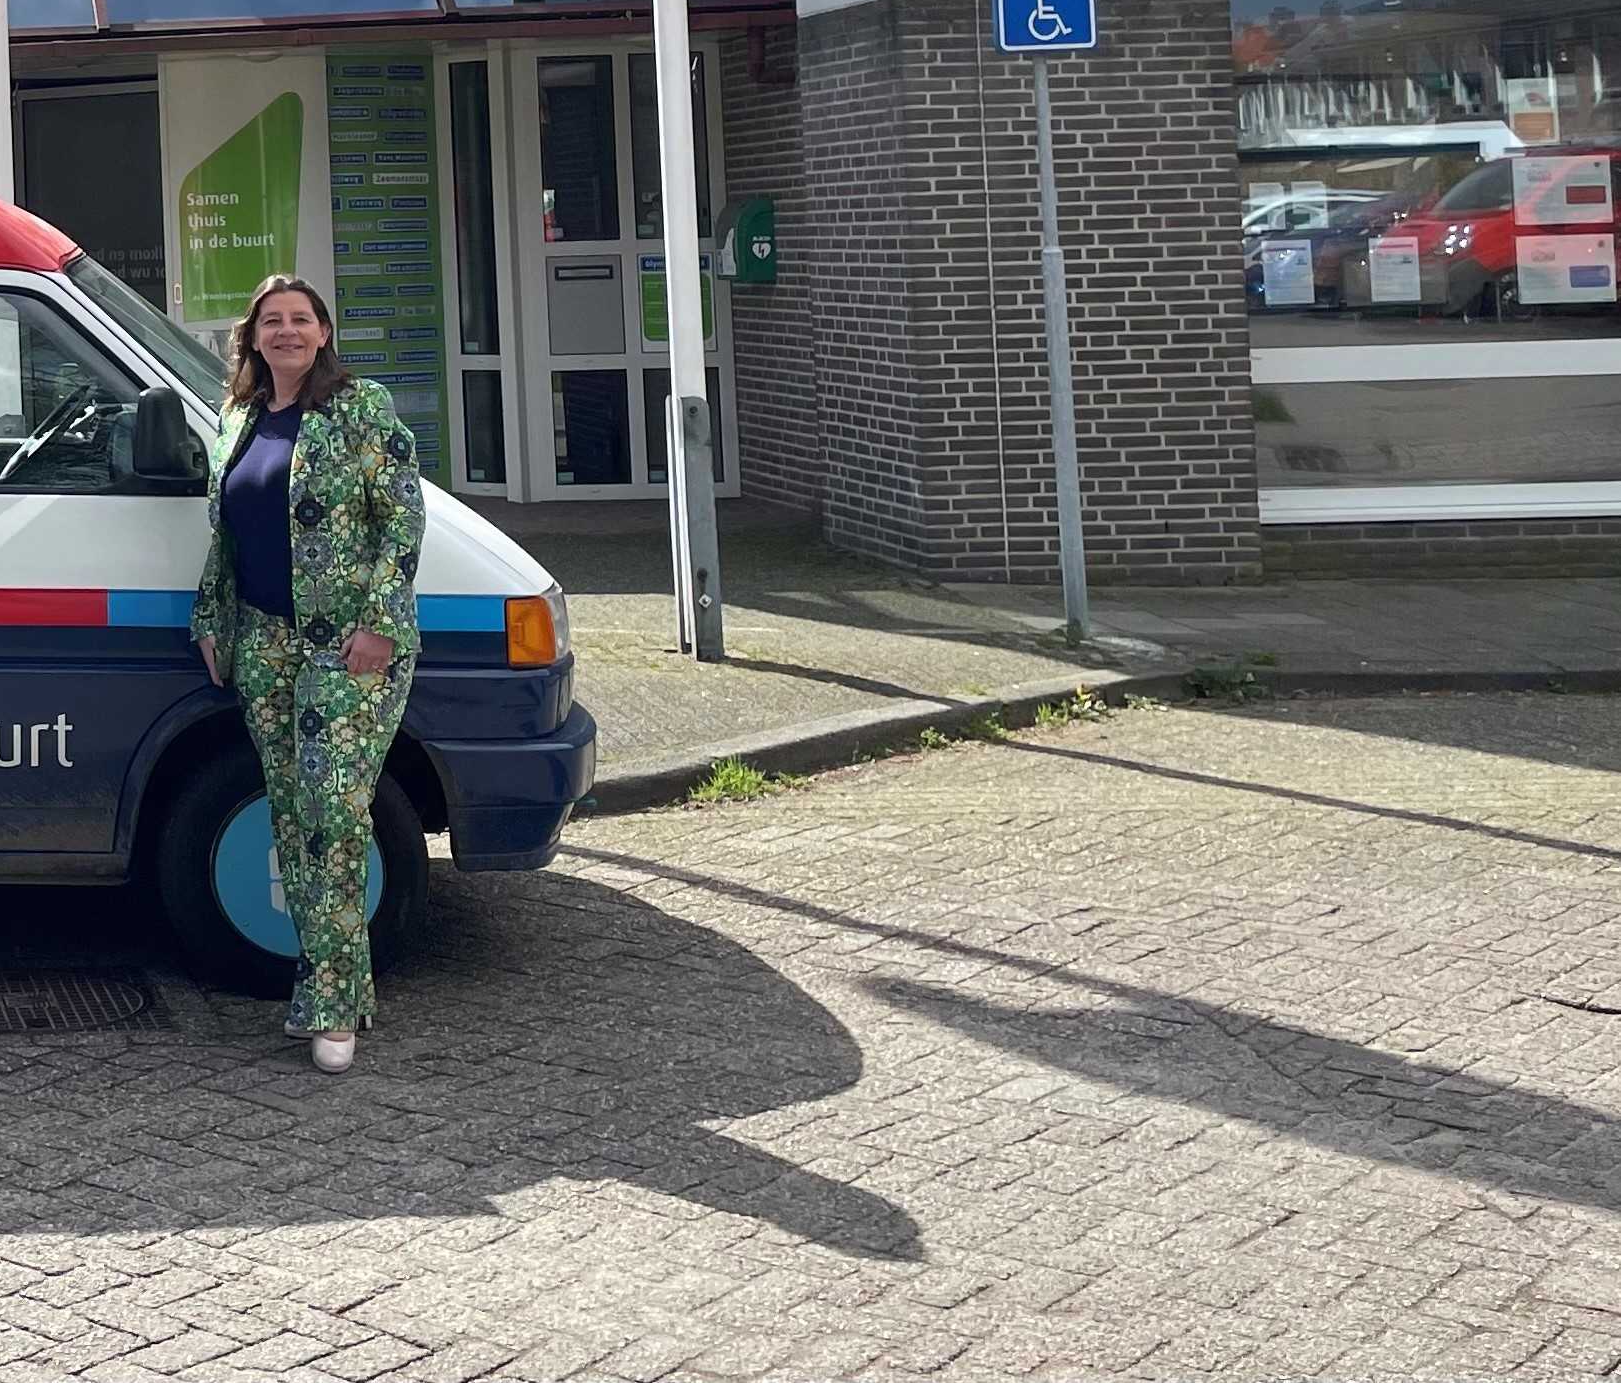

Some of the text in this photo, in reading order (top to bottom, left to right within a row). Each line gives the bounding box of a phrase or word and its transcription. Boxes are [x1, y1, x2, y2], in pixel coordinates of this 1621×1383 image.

[186, 192, 240, 207] Samen
[187, 212, 227, 228] thuis
[189, 232, 275, 250] in de buurt
